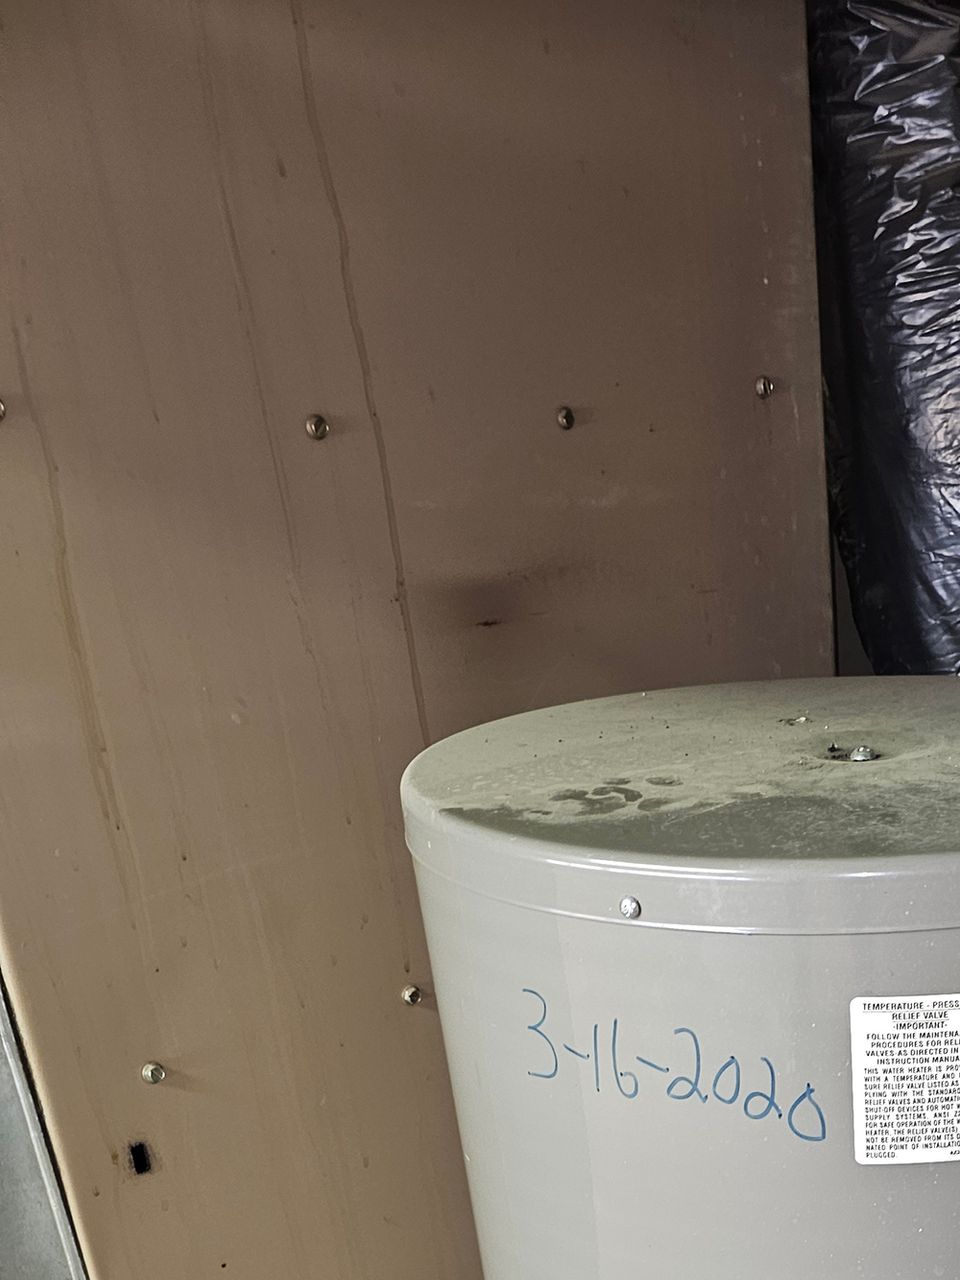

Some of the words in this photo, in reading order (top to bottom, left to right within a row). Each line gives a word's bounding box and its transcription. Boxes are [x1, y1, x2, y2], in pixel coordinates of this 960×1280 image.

[863, 1002, 923, 1010] TEMPERATURE
[892, 1012, 920, 1020] RELIEF
[924, 1011, 948, 1019] VALVE
[910, 1048, 948, 1056] DIRECTED
[522, 988, 827, 1142] 3-16-2020
[877, 1057, 929, 1065] INSTRUCTION
[928, 1088, 960, 1096] STANDARD
[897, 1120, 931, 1128] OPERATION
